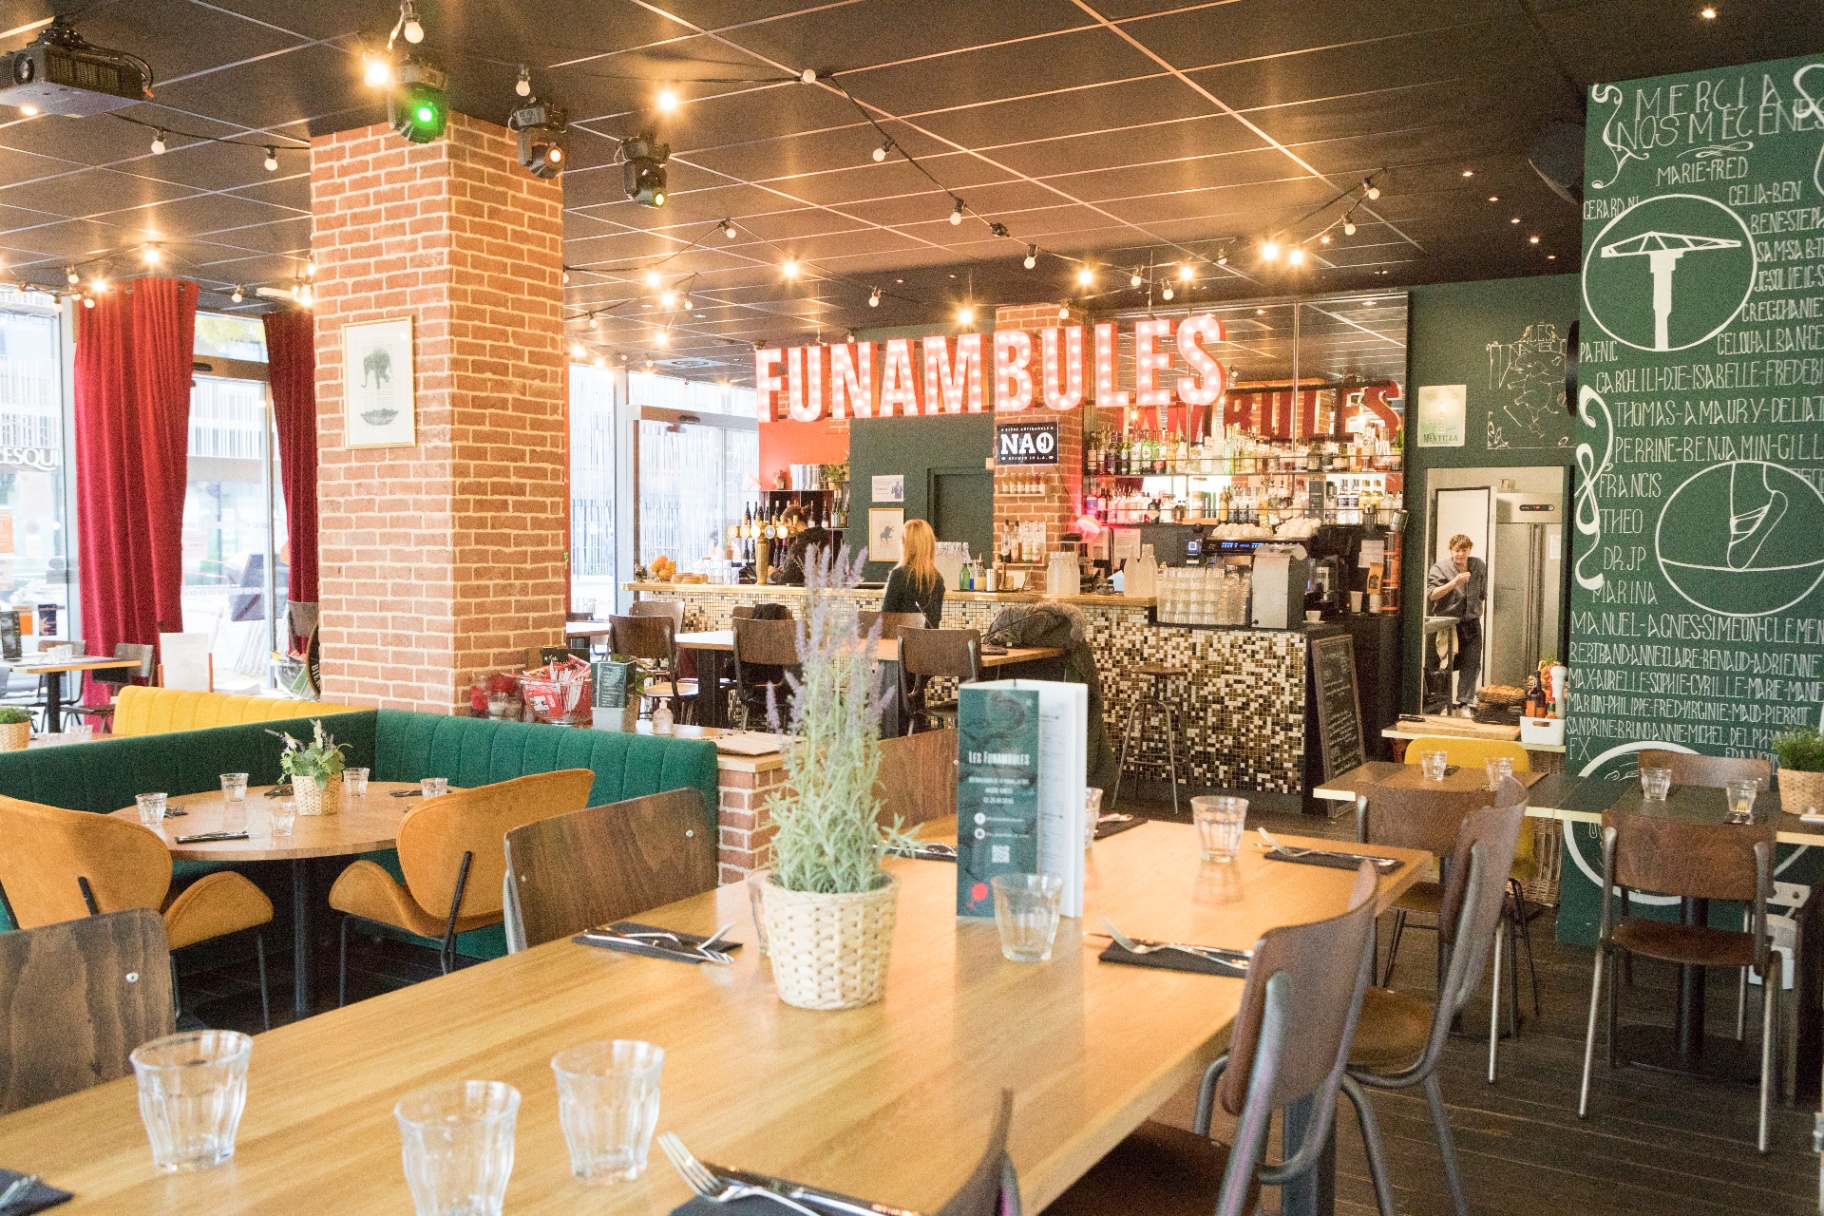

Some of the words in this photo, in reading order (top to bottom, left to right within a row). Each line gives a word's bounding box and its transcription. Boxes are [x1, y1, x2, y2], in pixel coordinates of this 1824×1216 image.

[1635, 76, 1744, 120] MERCI
[1617, 115, 1680, 151] NOS
[1656, 157, 1748, 186] MARIE-FRED
[756, 315, 1226, 422] FUNAMBULES
[1000, 432, 1055, 454] NAO
[1599, 472, 1662, 498] FRANCIS
[1599, 508, 1643, 533] THEO
[1592, 580, 1658, 604] MARINA
[1569, 737, 1592, 761] FX
